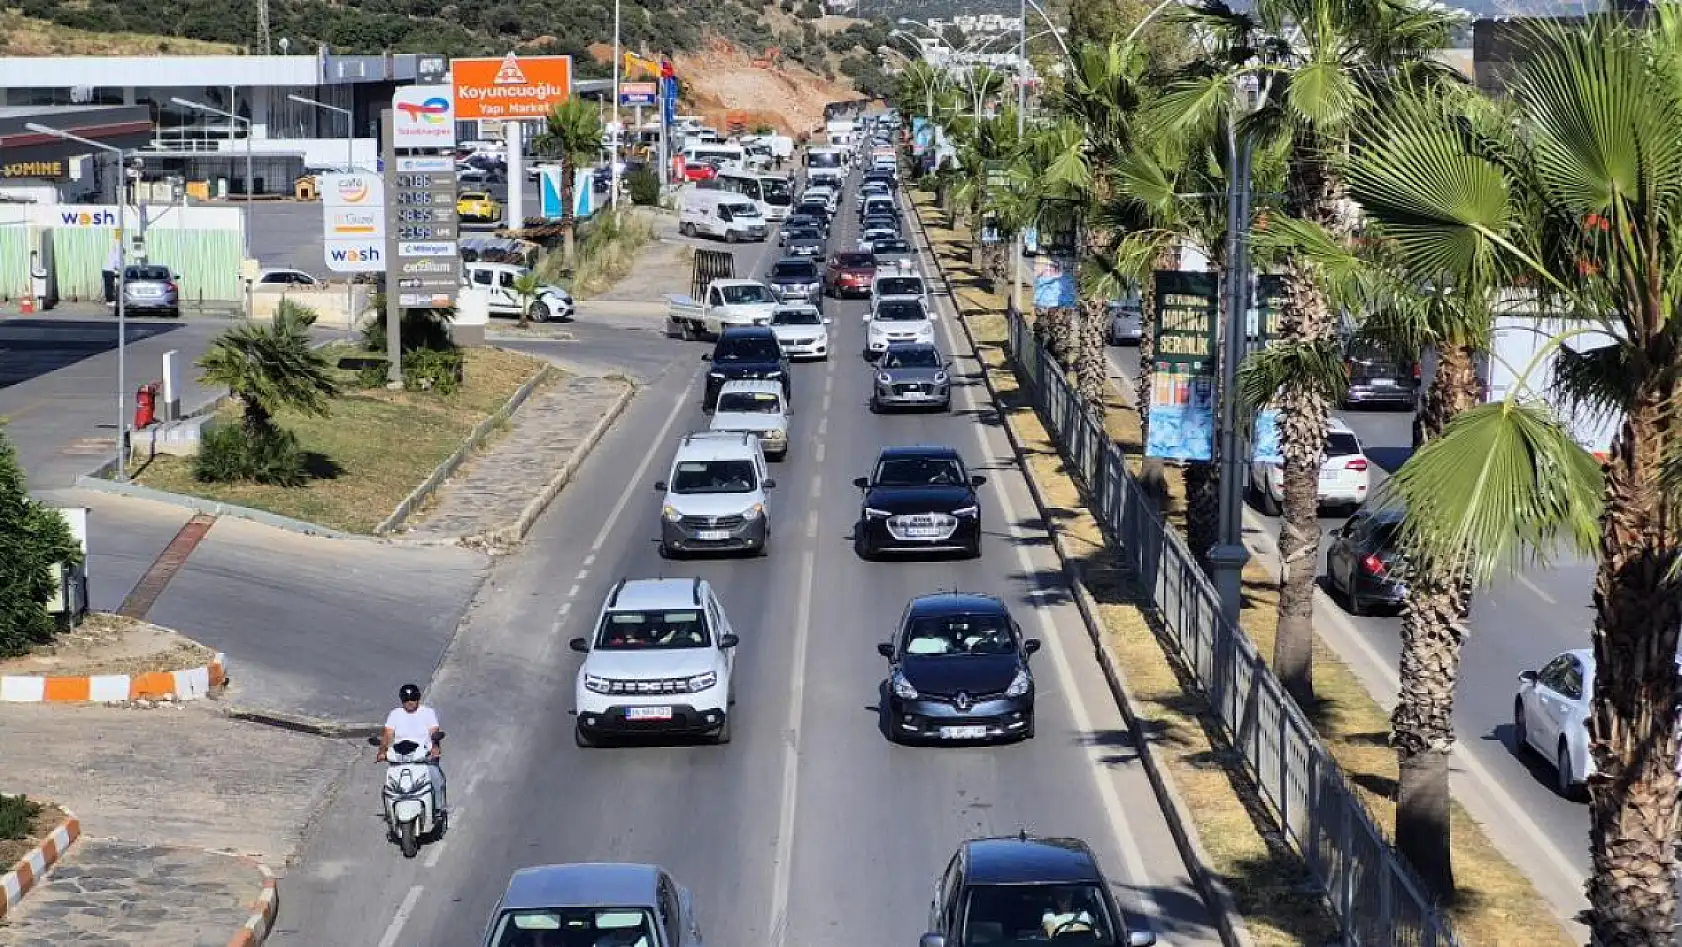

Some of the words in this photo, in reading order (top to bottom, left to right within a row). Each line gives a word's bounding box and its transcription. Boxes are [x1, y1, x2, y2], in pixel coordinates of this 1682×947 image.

[458, 81, 561, 99] Koyuncuoğlu
[479, 103, 504, 115] Yapı
[509, 101, 550, 113] Market
[61, 209, 115, 226] wash
[331, 245, 379, 263] wash
